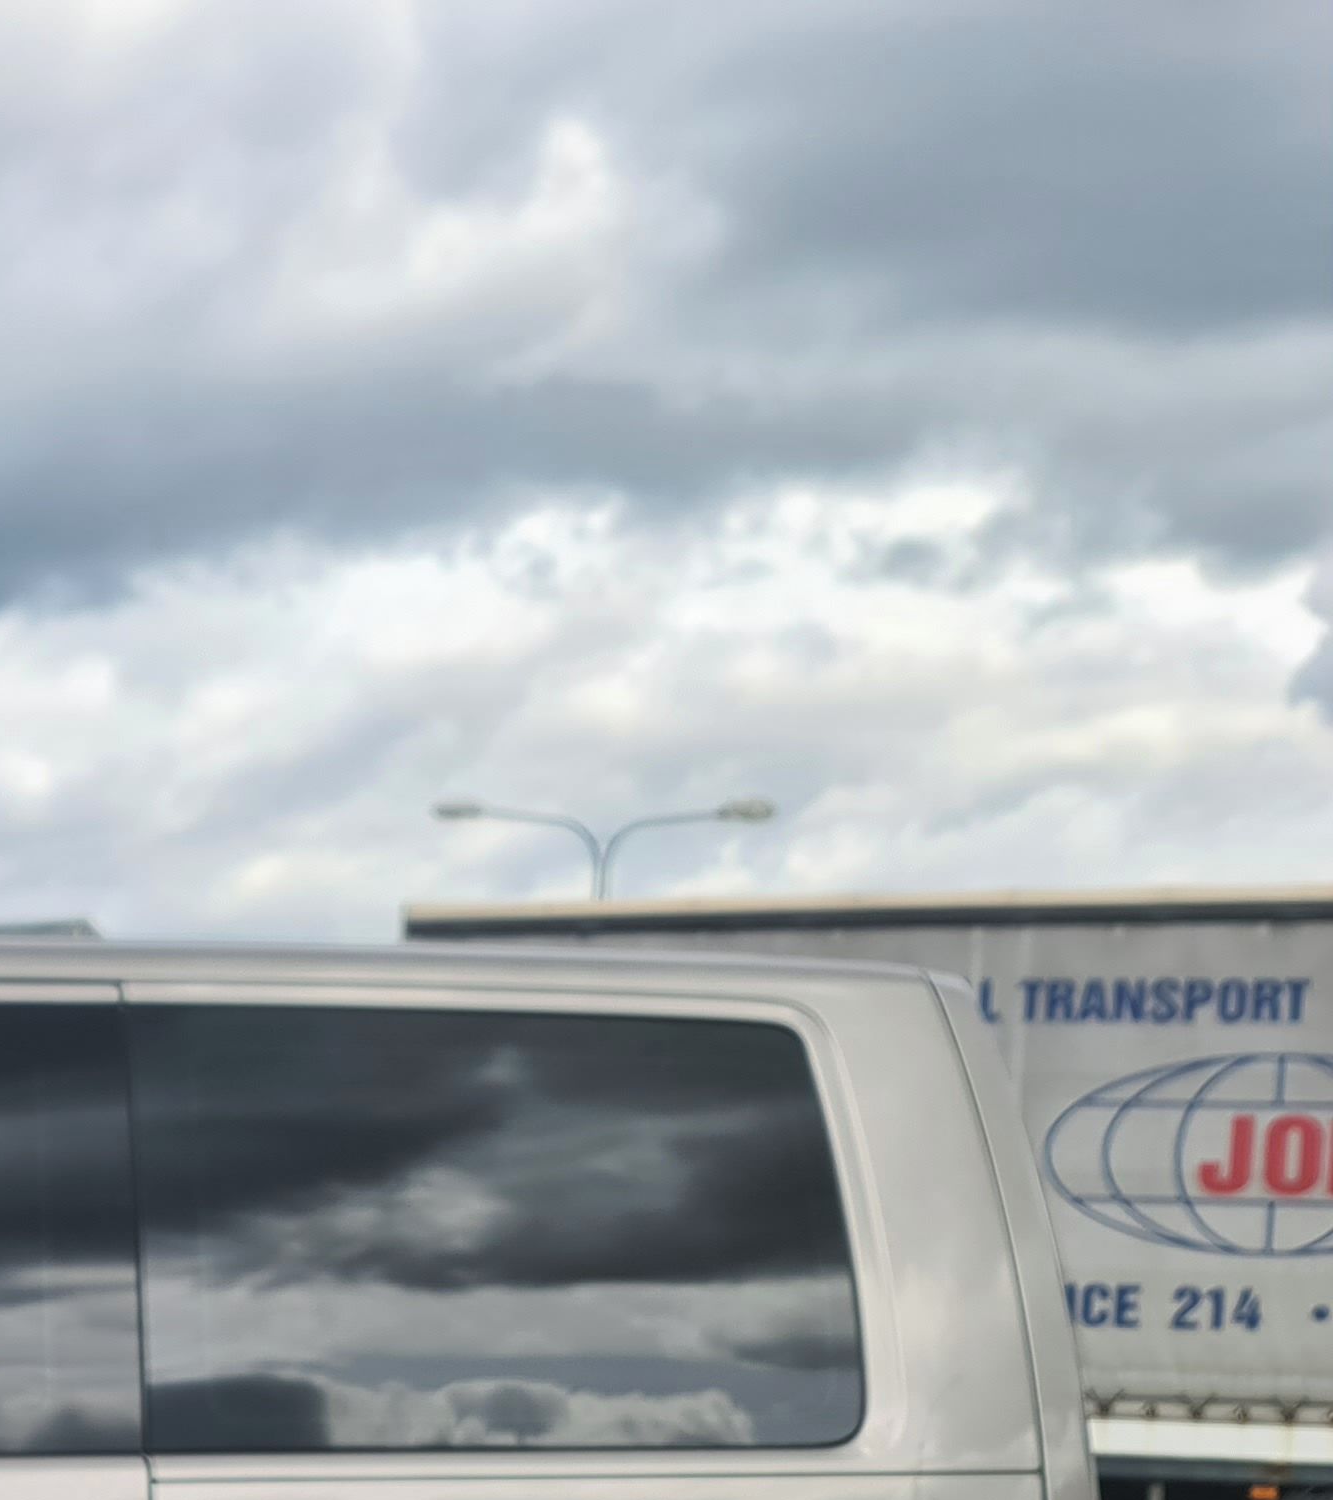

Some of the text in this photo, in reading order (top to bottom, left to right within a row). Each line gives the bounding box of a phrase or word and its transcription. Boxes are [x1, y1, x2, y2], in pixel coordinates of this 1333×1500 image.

[1017, 977, 1309, 1023] TRANSPORT
[1198, 1114, 1333, 1196] JO
[1171, 1286, 1261, 1331] 214
